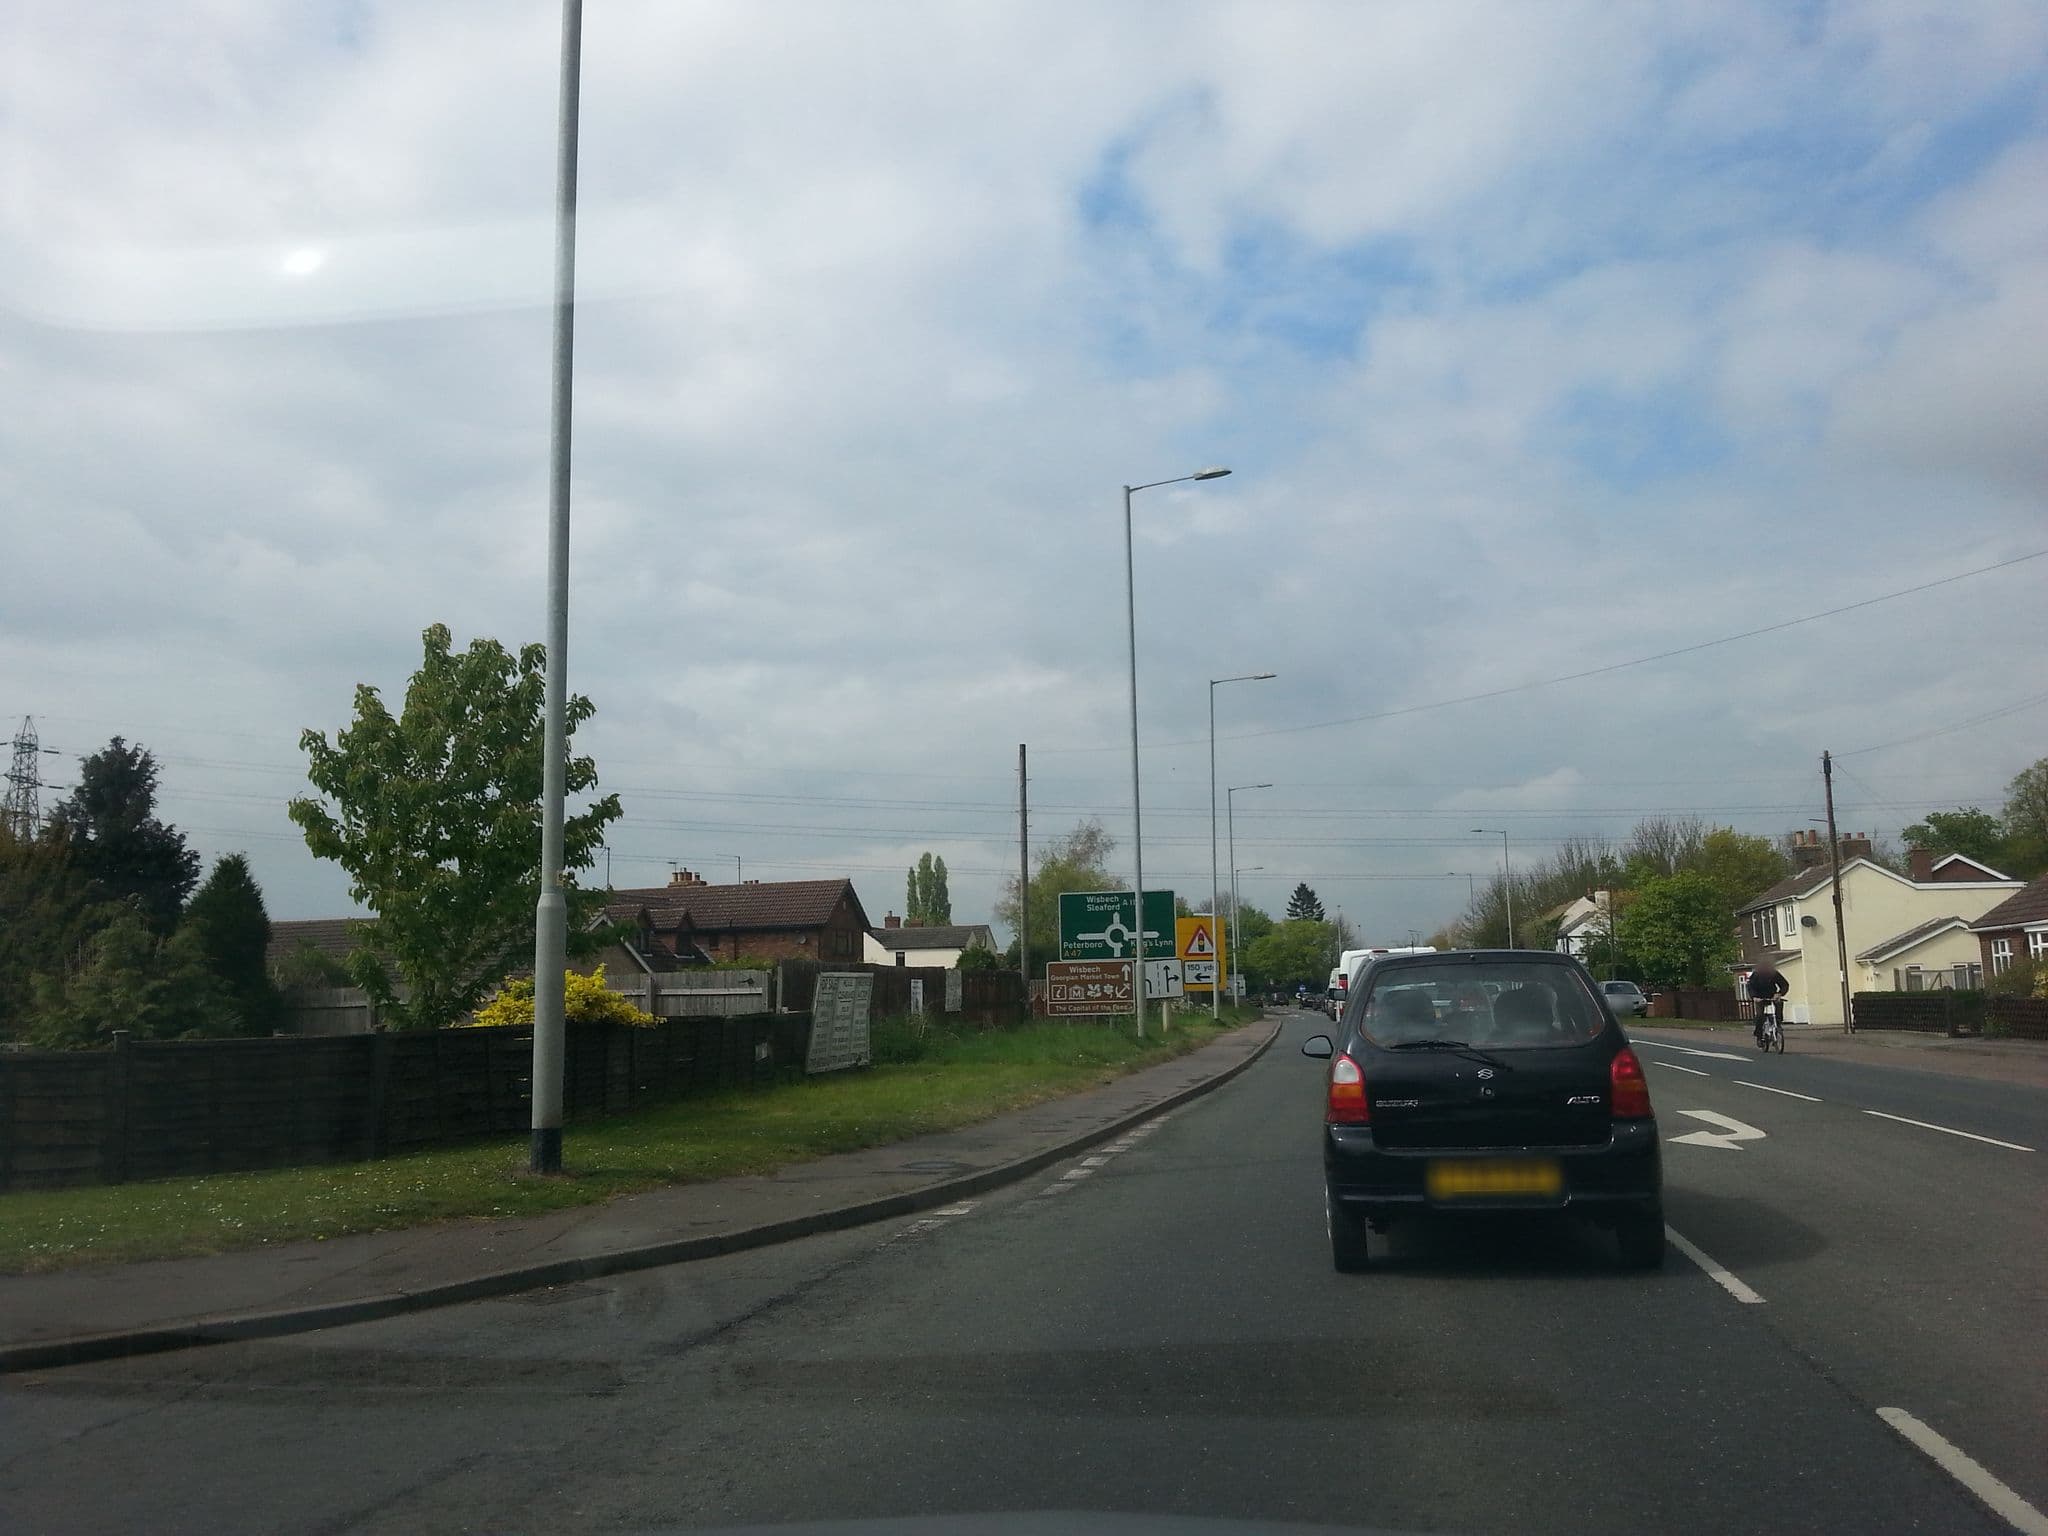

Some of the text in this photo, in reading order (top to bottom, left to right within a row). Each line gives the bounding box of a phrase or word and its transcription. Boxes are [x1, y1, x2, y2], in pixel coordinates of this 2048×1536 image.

[1086, 895, 1120, 904] Wisbech
[1086, 903, 1121, 912] Sleaford
[1154, 938, 1173, 948] Lynn
[1069, 965, 1101, 974] Wisbech
[1187, 963, 1201, 971] 150
[1050, 974, 1079, 982] Georgian
[1068, 1004, 1091, 1013] Capital
[1566, 1095, 1601, 1105] ALTO
